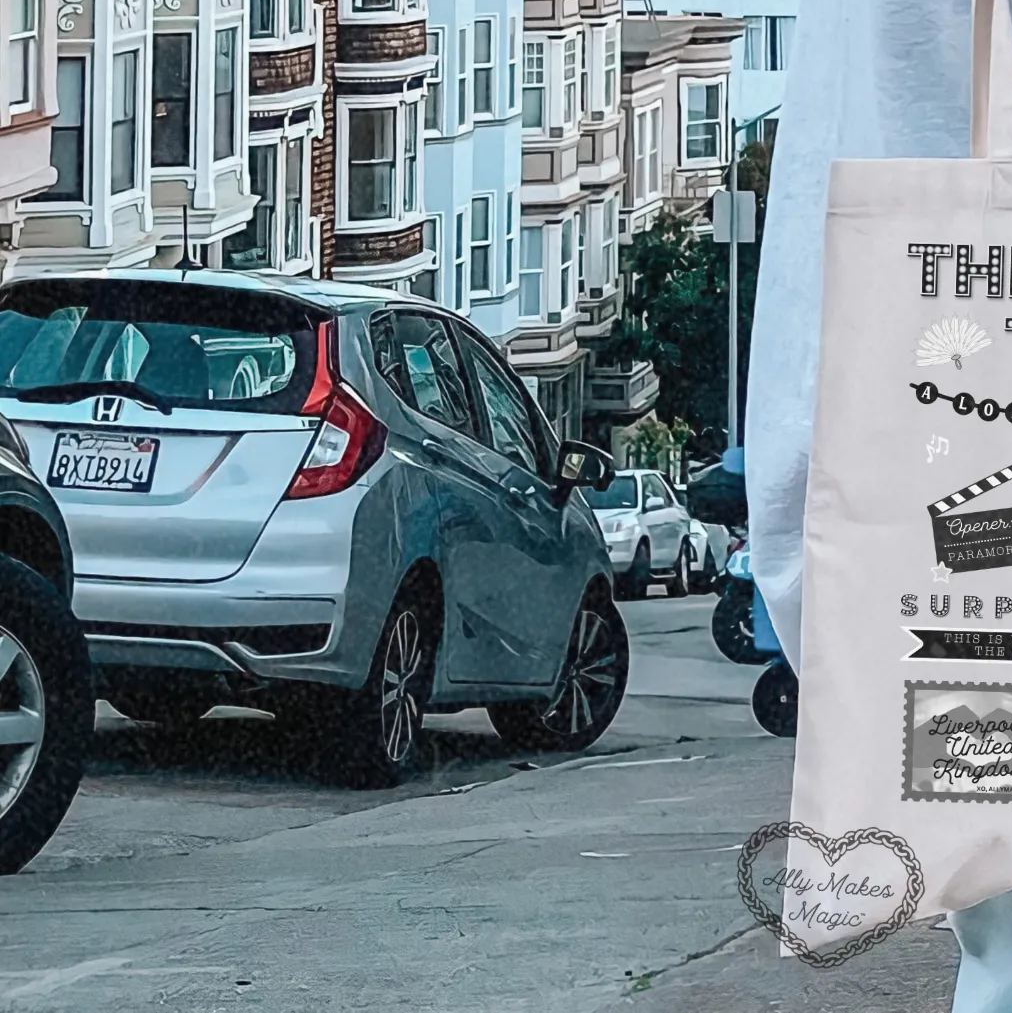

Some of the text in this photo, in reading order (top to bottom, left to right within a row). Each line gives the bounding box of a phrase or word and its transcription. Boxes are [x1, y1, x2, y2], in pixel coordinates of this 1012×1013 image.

[946, 518, 1012, 538] Opener:
[943, 632, 981, 644] THIS
[988, 634, 1003, 645] IS
[974, 646, 1005, 657] THE
